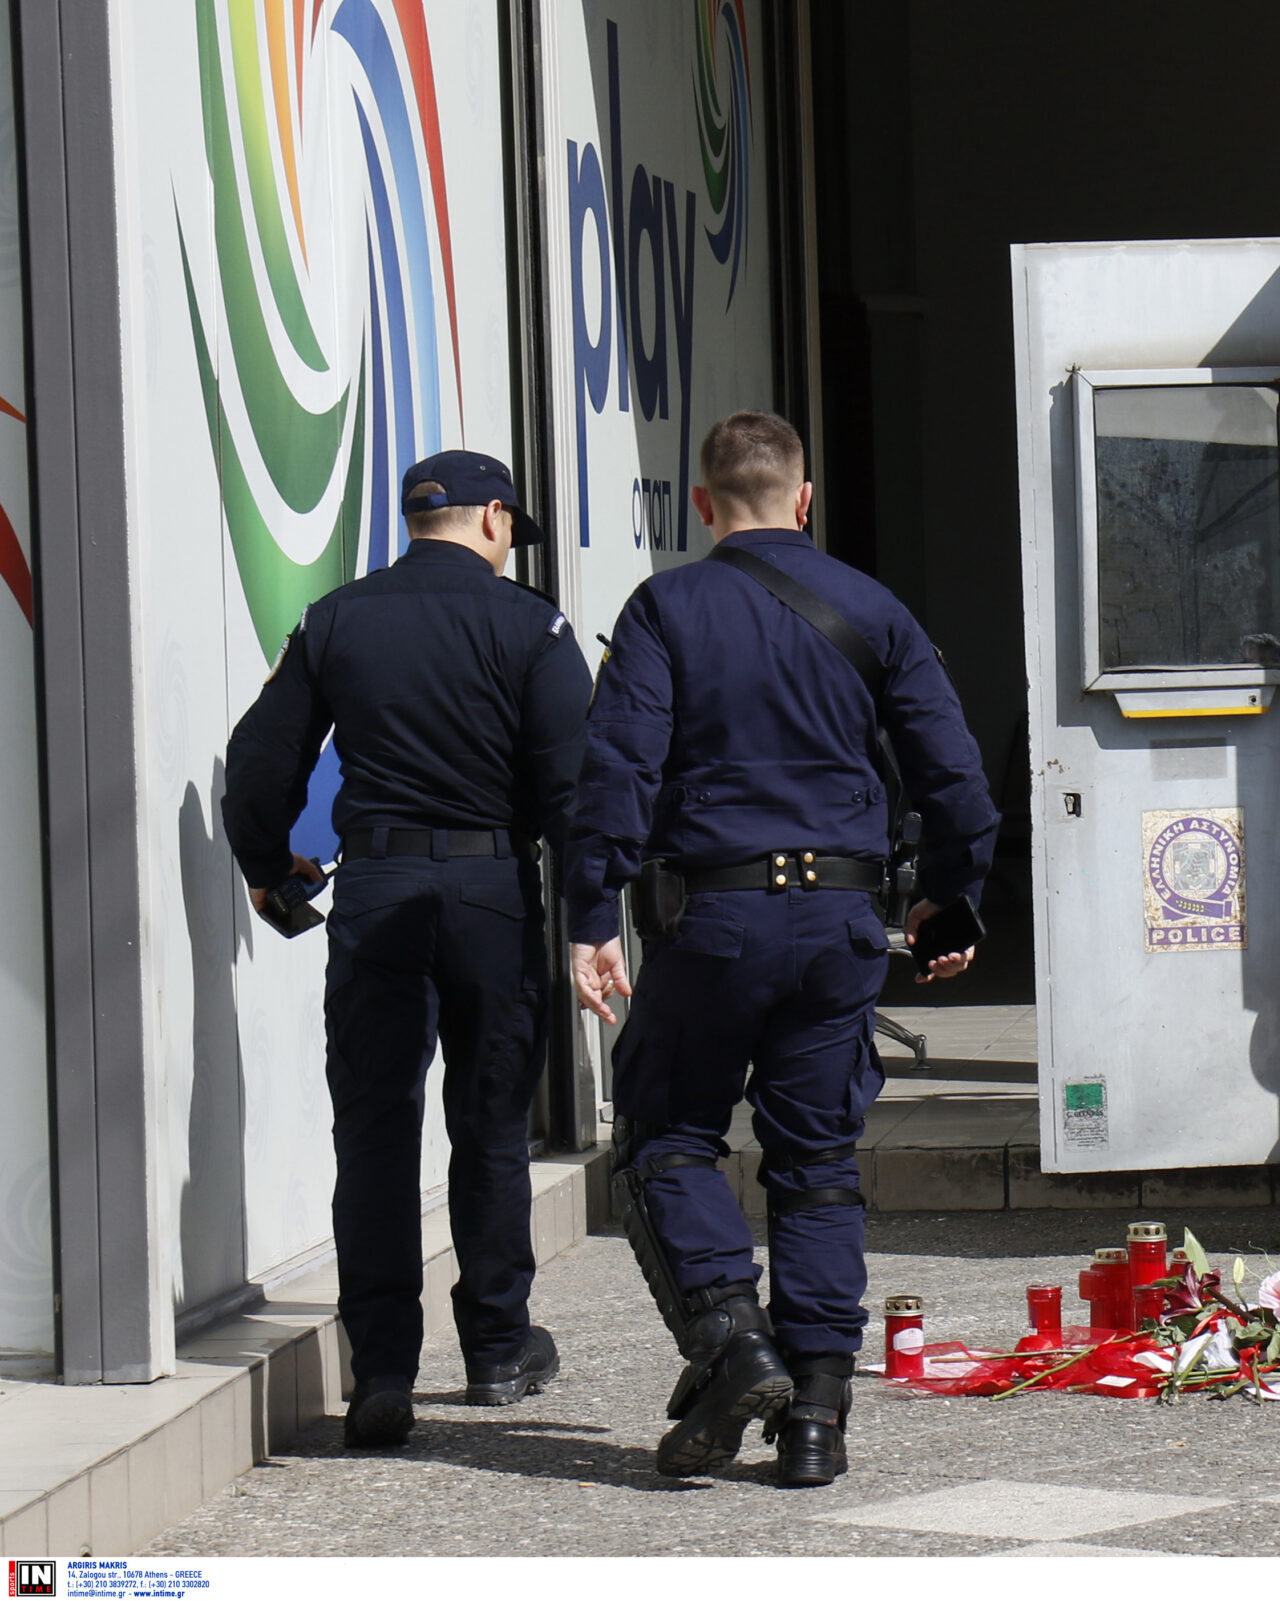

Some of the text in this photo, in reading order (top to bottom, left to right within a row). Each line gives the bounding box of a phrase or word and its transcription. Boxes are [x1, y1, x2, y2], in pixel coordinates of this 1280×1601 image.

[566, 18, 697, 552] play
[1150, 819, 1240, 900] ΕΛΛΗΝΙΚΗ ΑΣΤΥΝΟΜΙΑ
[1152, 926, 1242, 944] POLICE
